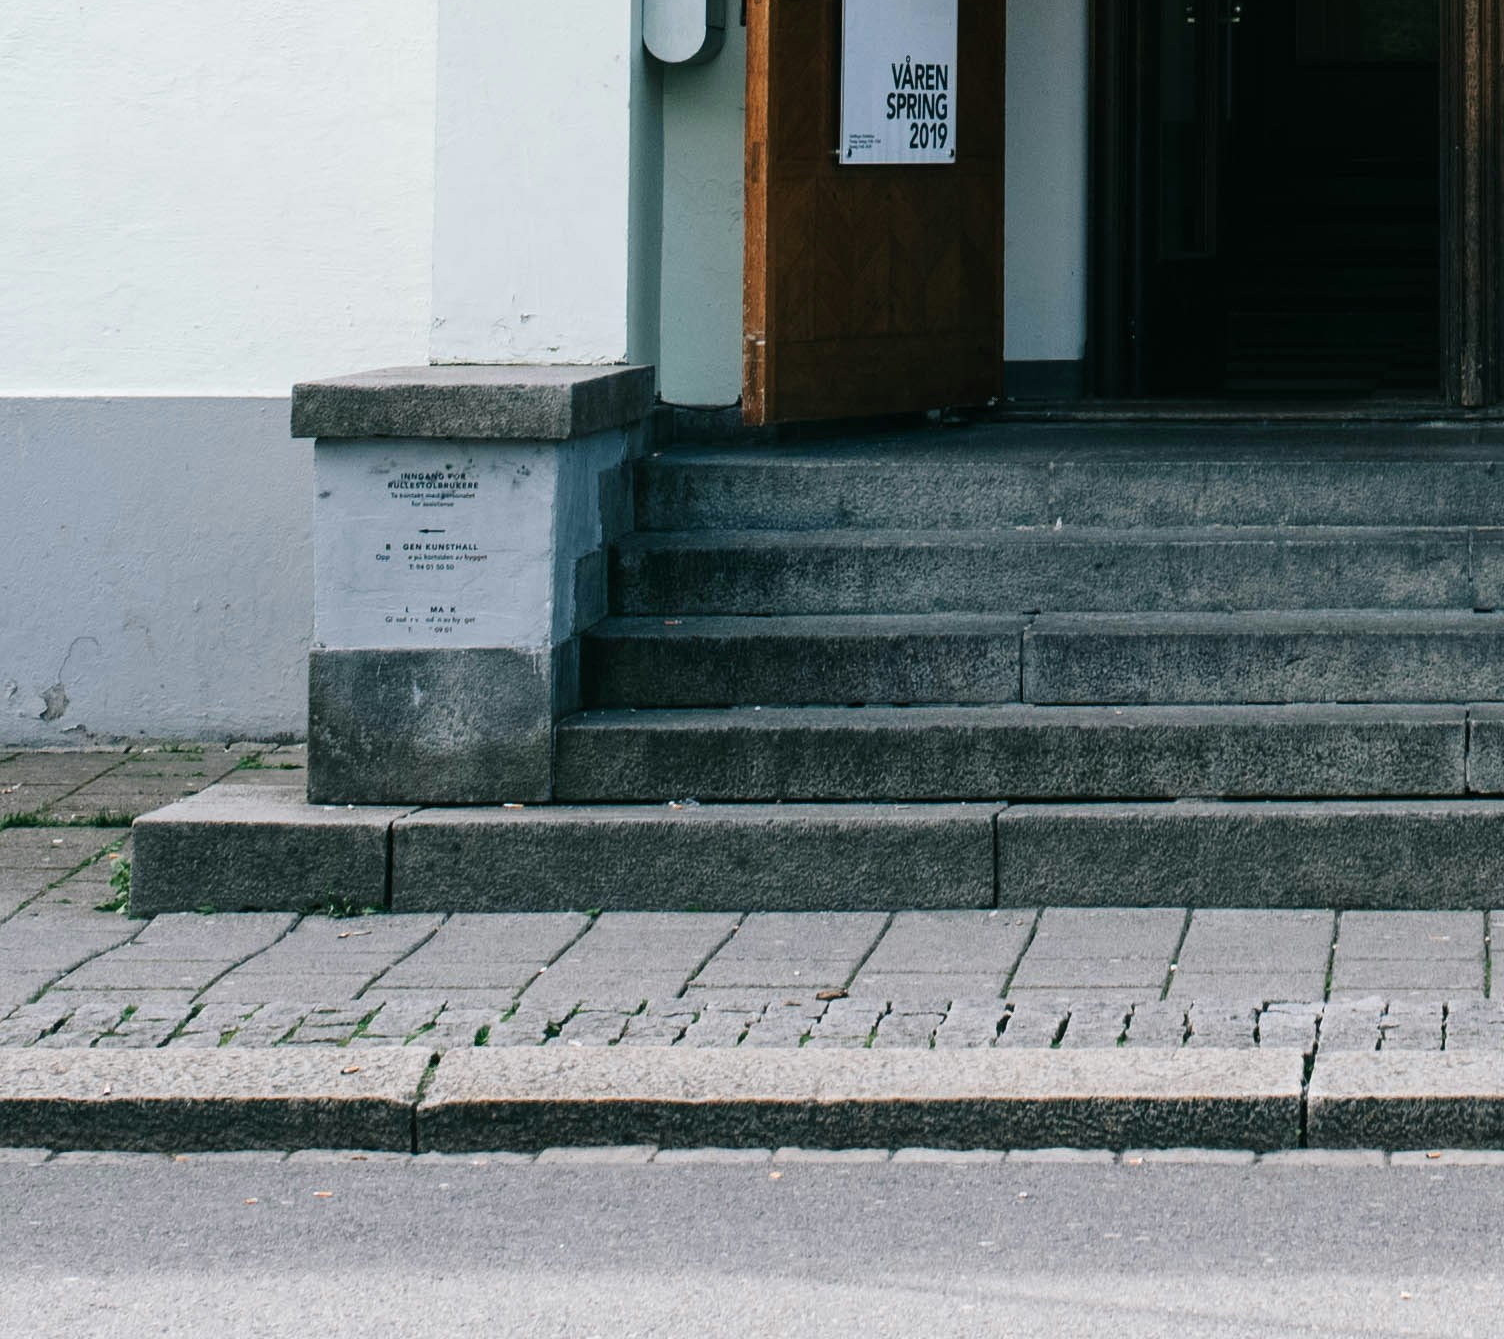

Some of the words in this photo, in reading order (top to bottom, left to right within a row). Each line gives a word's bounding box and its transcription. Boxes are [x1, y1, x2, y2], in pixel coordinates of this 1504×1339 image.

[892, 55, 949, 91] VÅREN
[886, 93, 948, 121] SPRING
[909, 122, 948, 149] 2019
[385, 543, 422, 551] BGEN
[425, 543, 479, 551] KUNSTHALL
